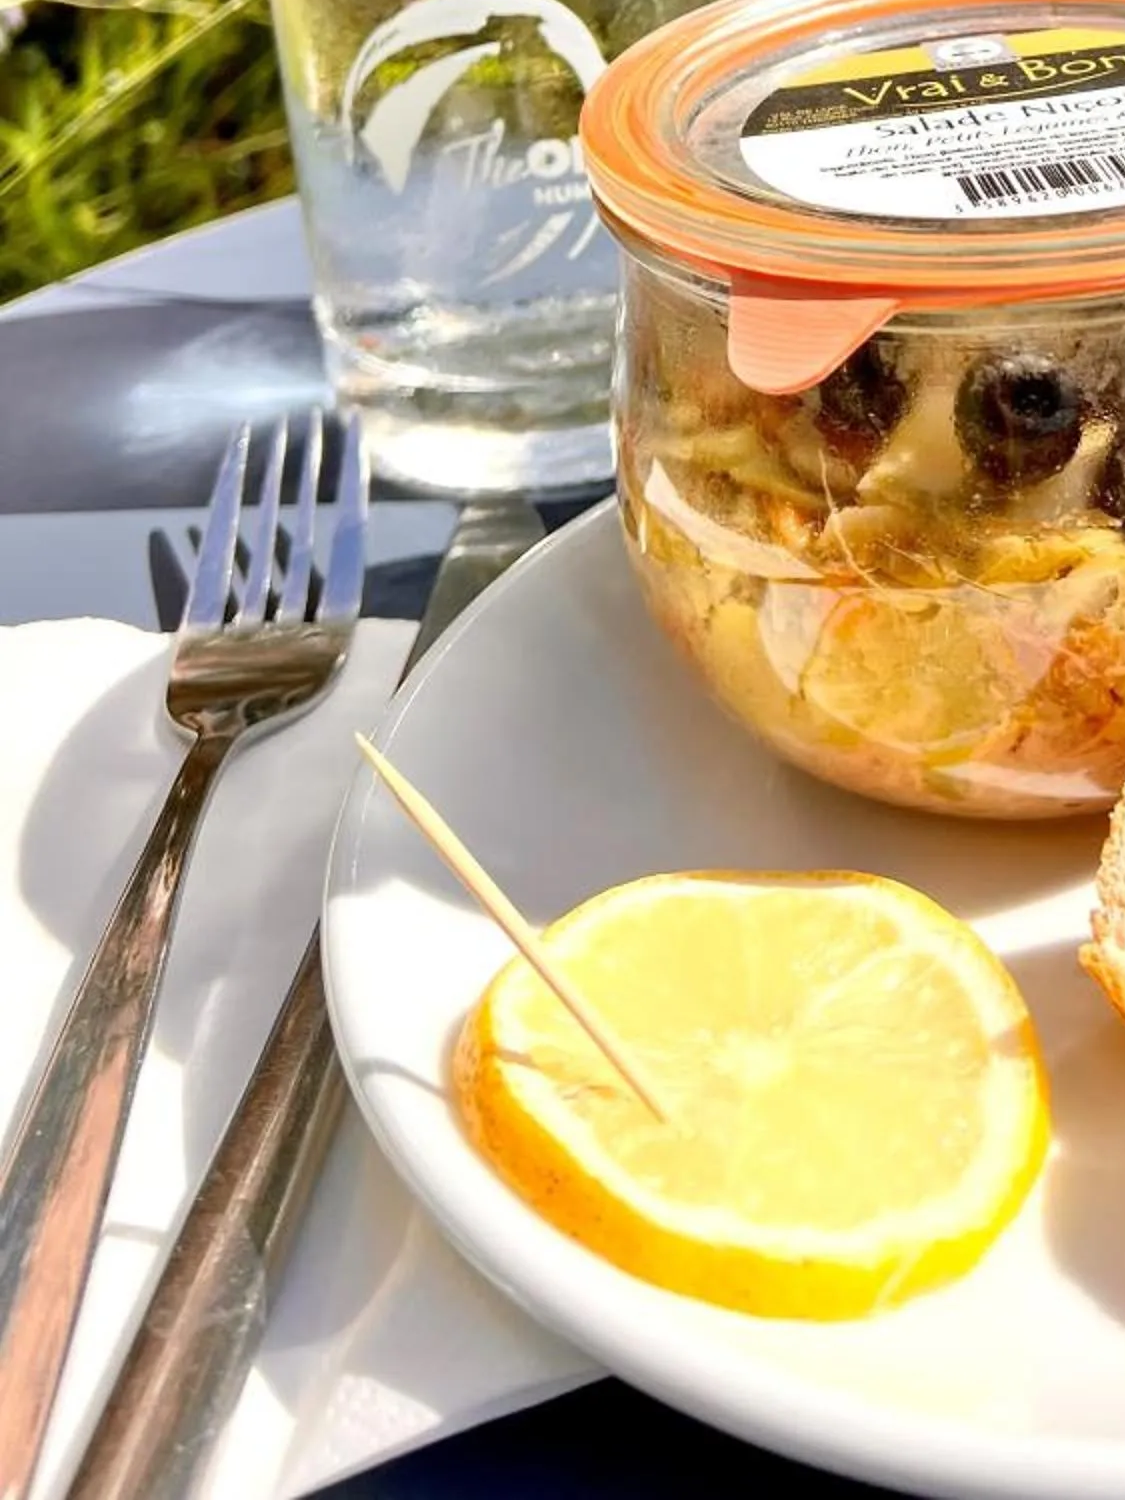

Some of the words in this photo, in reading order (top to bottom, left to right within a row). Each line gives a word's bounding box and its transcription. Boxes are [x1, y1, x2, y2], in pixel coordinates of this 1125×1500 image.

[843, 74, 966, 106] Vrai
[978, 72, 1010, 89] &
[874, 109, 1009, 140] Salade
